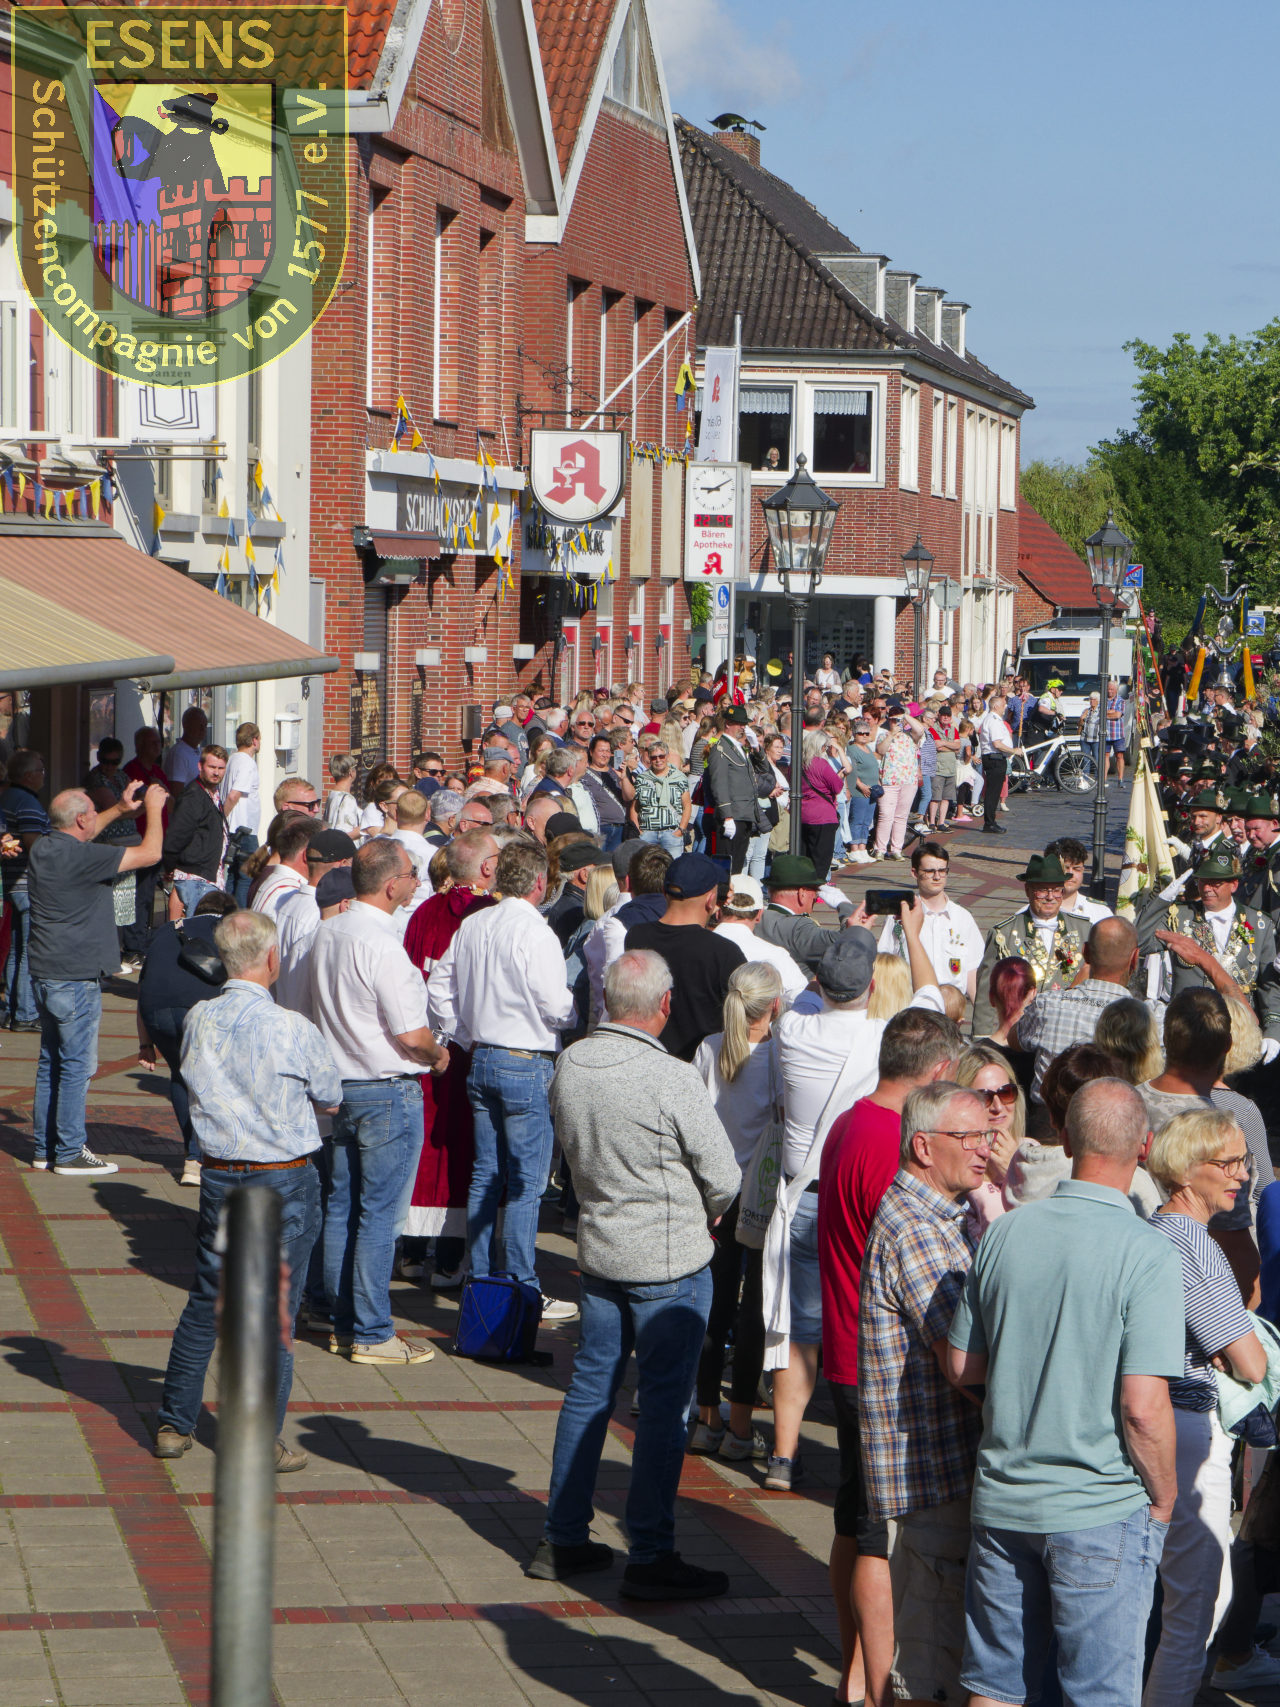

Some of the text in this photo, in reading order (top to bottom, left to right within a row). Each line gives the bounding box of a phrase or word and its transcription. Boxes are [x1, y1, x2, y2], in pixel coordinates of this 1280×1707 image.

[694, 514, 711, 528] 22
[701, 530, 726, 539] Bären
[693, 540, 733, 550] Apotheke
